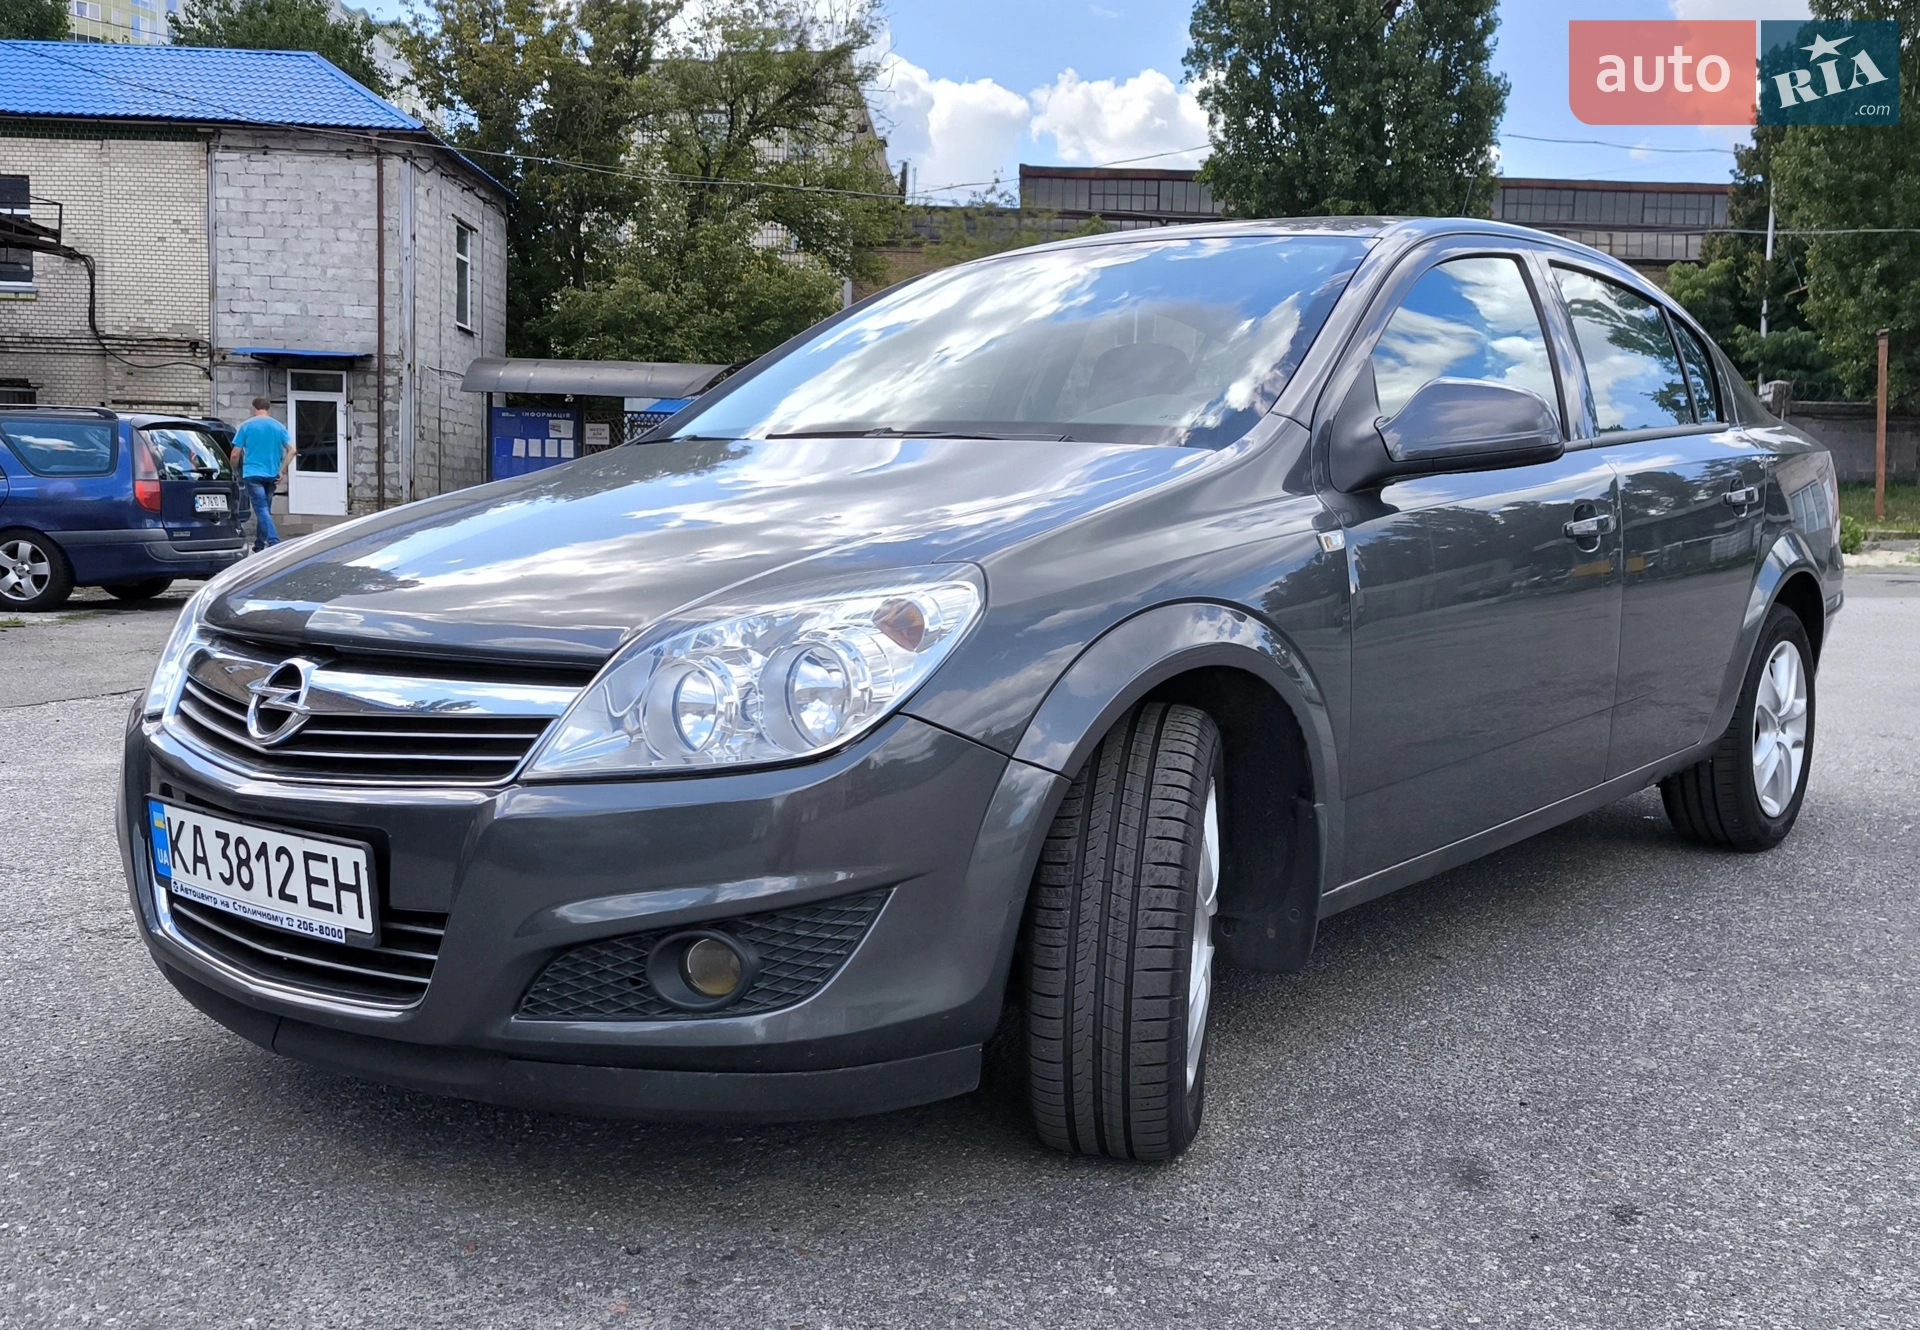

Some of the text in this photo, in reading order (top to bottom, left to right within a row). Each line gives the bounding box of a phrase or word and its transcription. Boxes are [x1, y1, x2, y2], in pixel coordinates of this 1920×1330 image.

[157, 847, 170, 866] UA
[179, 884, 343, 940] Автоцентр на Столичному 206-8000
